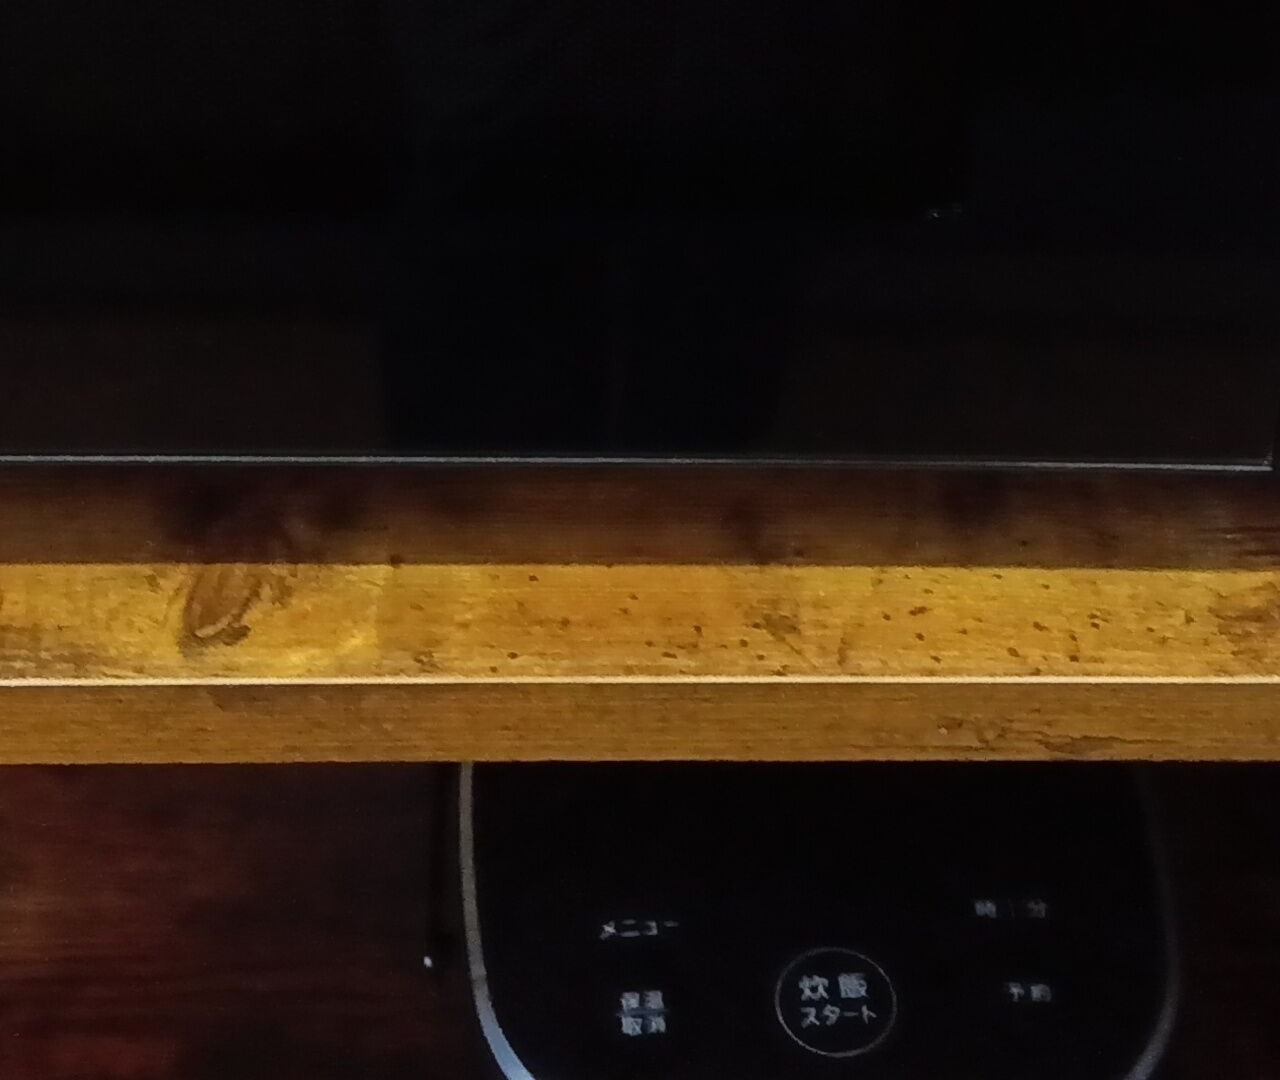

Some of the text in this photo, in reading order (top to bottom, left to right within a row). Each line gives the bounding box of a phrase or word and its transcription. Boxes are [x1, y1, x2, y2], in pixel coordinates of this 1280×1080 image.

[599, 919, 680, 940] メニュー
[798, 972, 870, 1001] 炊飯
[800, 1003, 878, 1028] スタート
